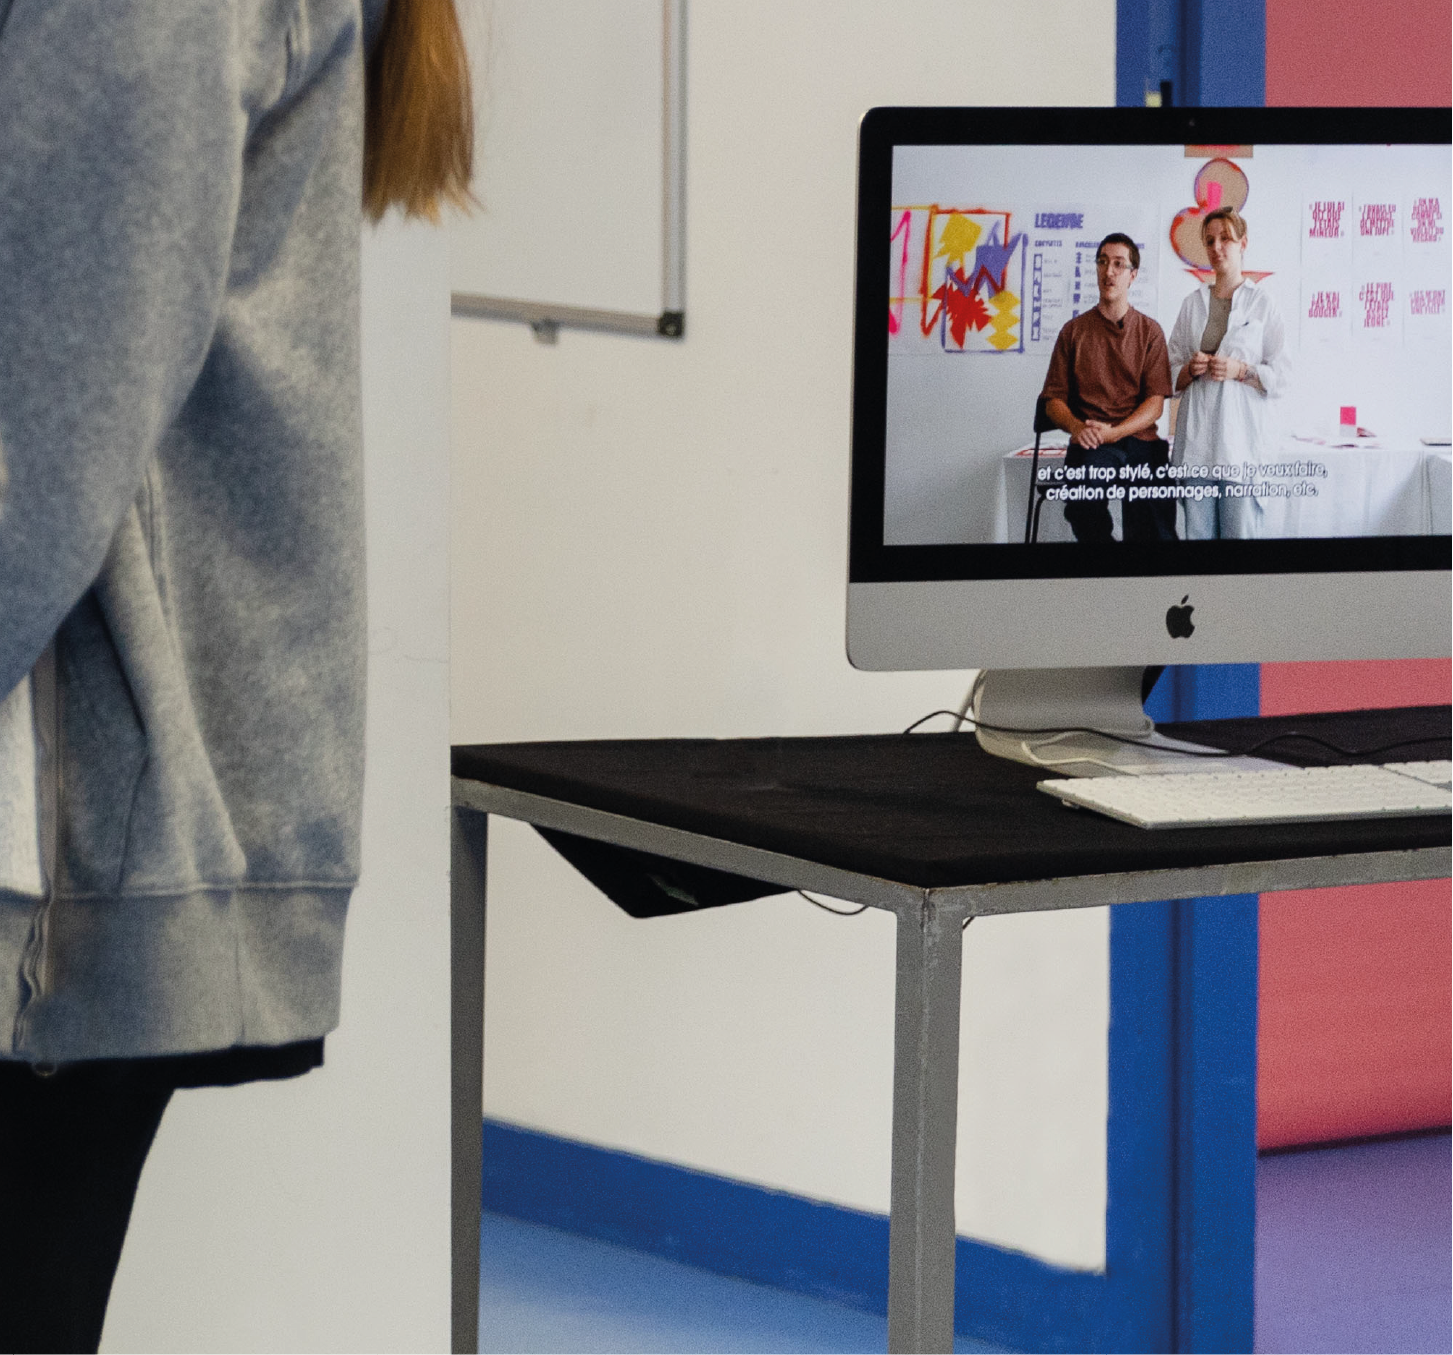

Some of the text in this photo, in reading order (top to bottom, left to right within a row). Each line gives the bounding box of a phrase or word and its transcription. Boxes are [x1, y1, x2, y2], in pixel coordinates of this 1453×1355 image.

[1037, 459, 1328, 483] et c'est trop stylé, c'est ce que je veux faire,
[1045, 483, 1104, 501] création
[1105, 483, 1126, 500] de
[1128, 484, 1222, 503] personnages,
[1224, 481, 1291, 499] narration,
